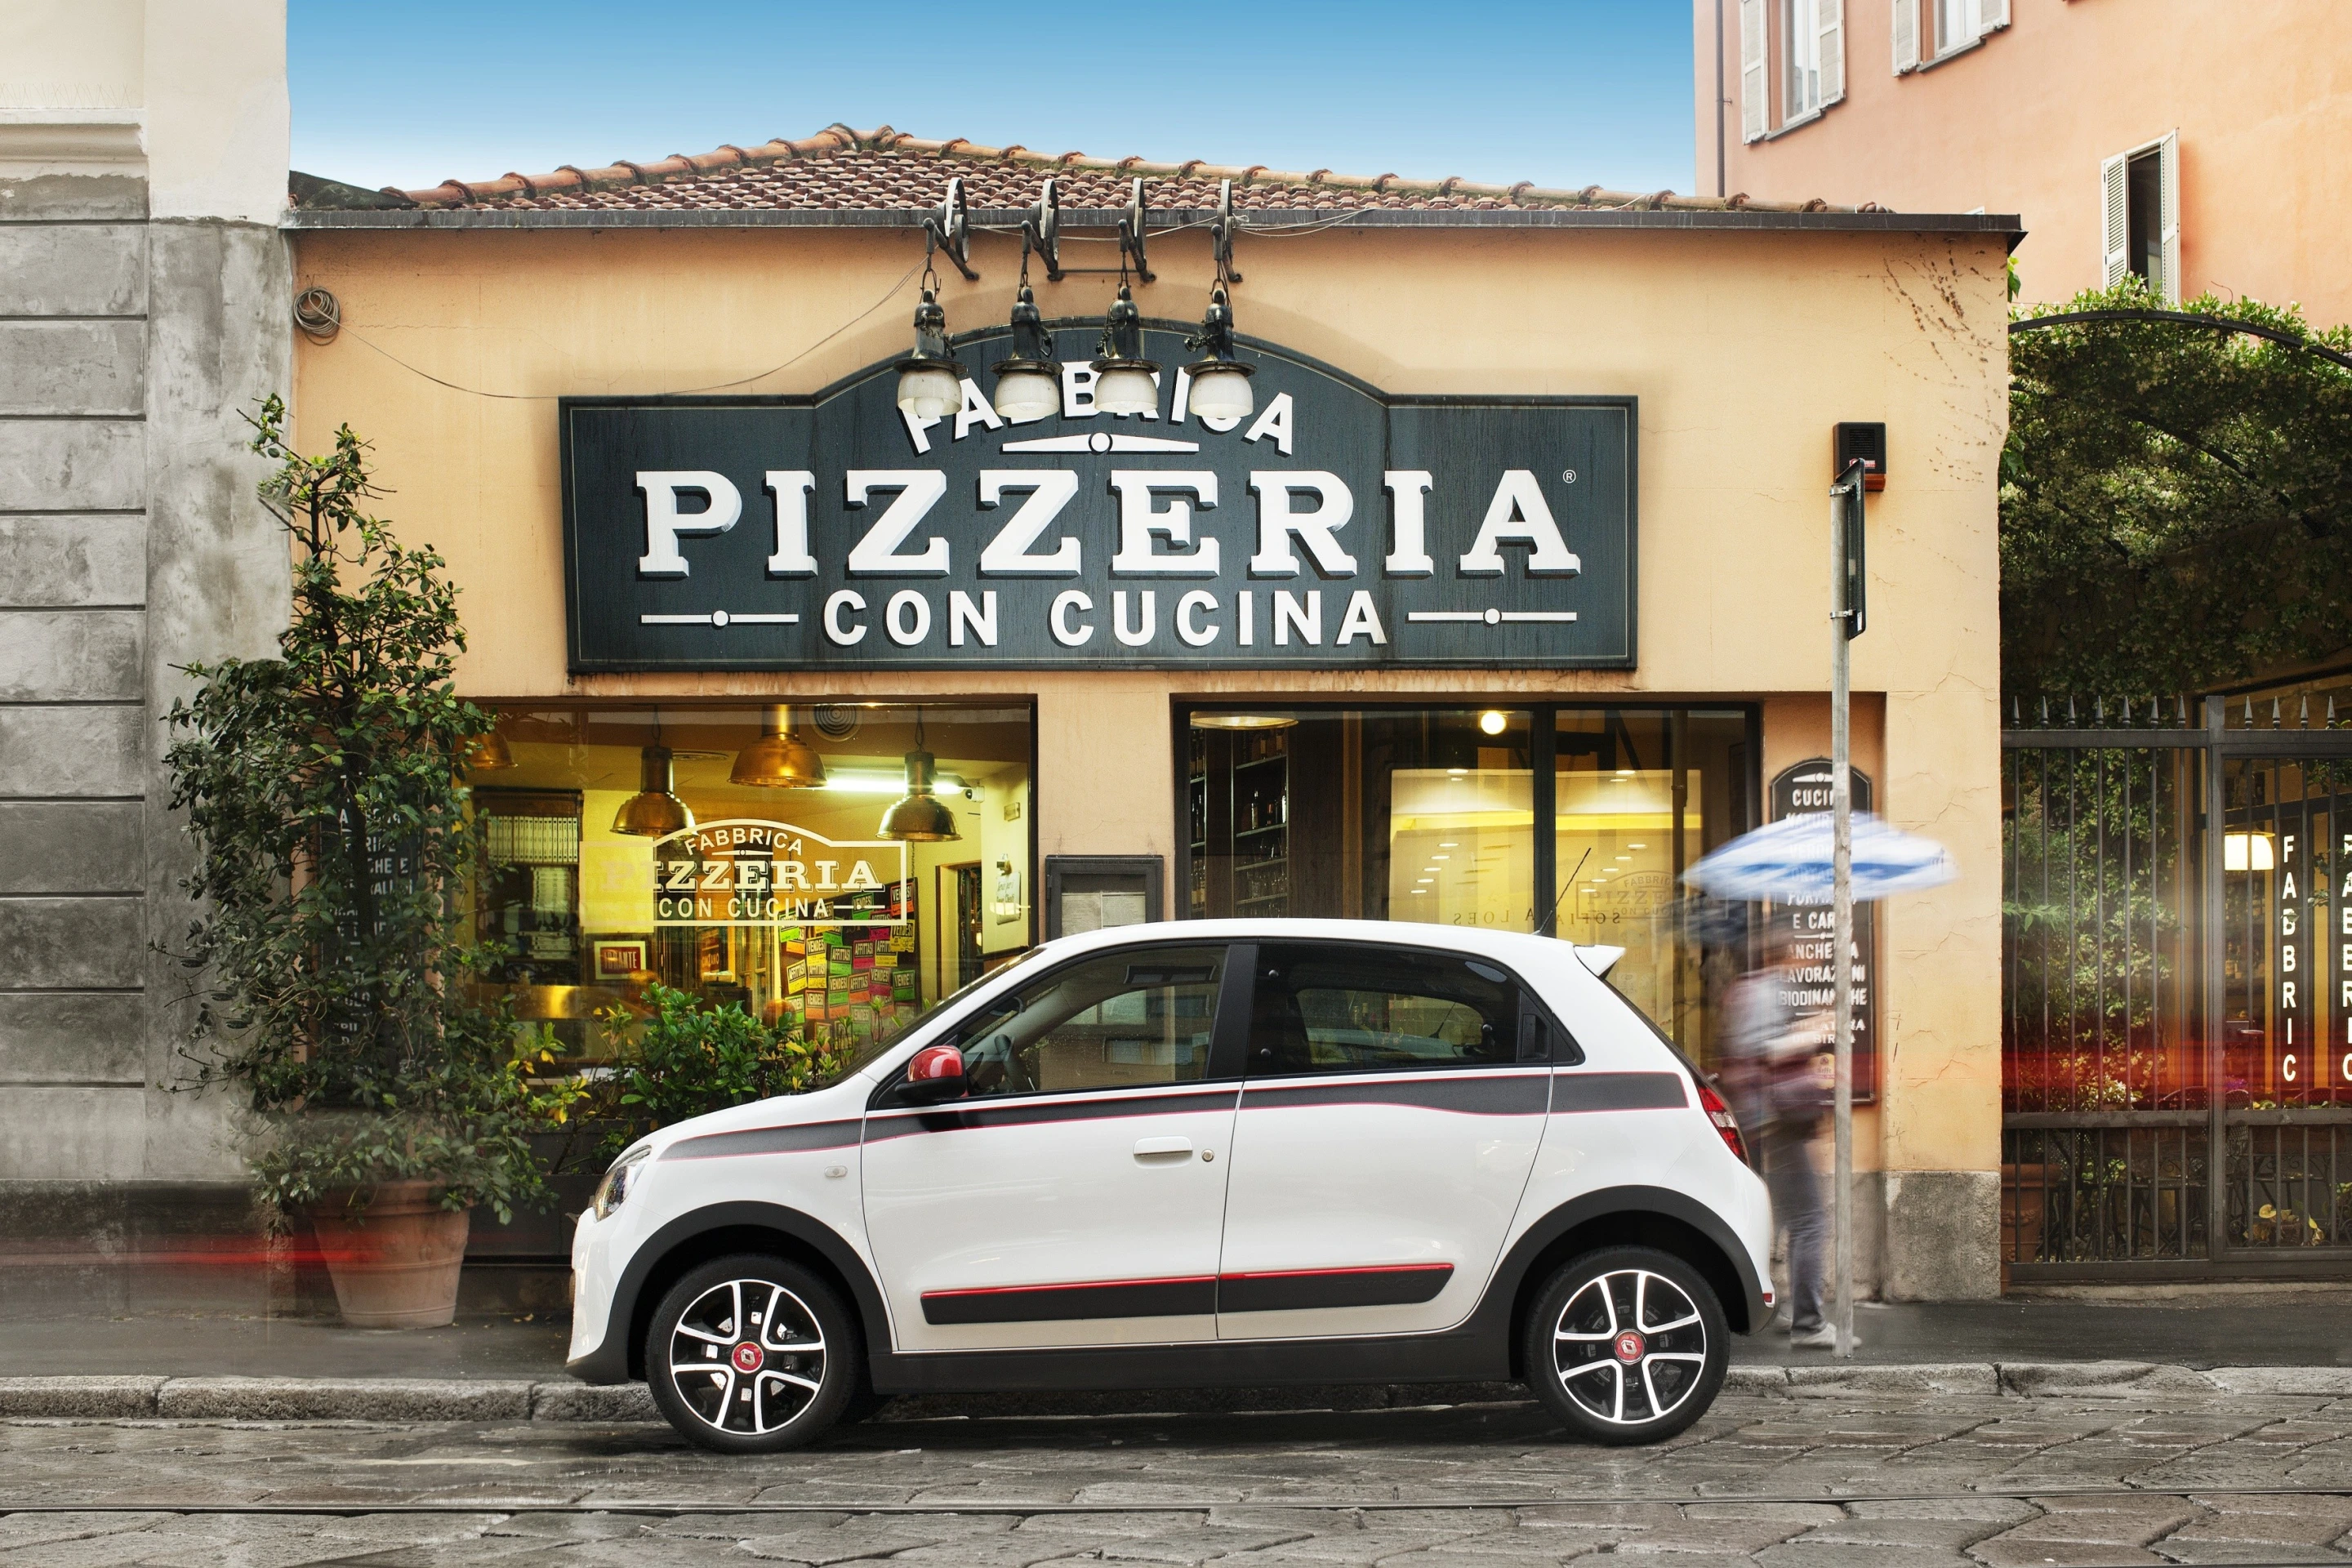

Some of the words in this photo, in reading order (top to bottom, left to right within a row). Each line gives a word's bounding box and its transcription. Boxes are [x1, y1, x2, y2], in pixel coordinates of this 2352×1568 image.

[900, 361, 1294, 455] FABIA
[634, 469, 1582, 577] PIZZERIA
[822, 589, 999, 648] CON
[1049, 589, 1387, 648] CUCINA
[1793, 789, 1834, 806] CUCI
[684, 827, 802, 855] FABBRICA
[599, 861, 885, 893] PIZZERIA
[1624, 876, 1673, 888] FABBRIC
[659, 897, 711, 918] CON
[728, 897, 827, 918] CUCINA
[1588, 891, 1667, 905] PIZZE
[1793, 913, 1801, 929] E
[1808, 911, 1835, 930] CAR
[1813, 1033, 1856, 1044] BIRA
